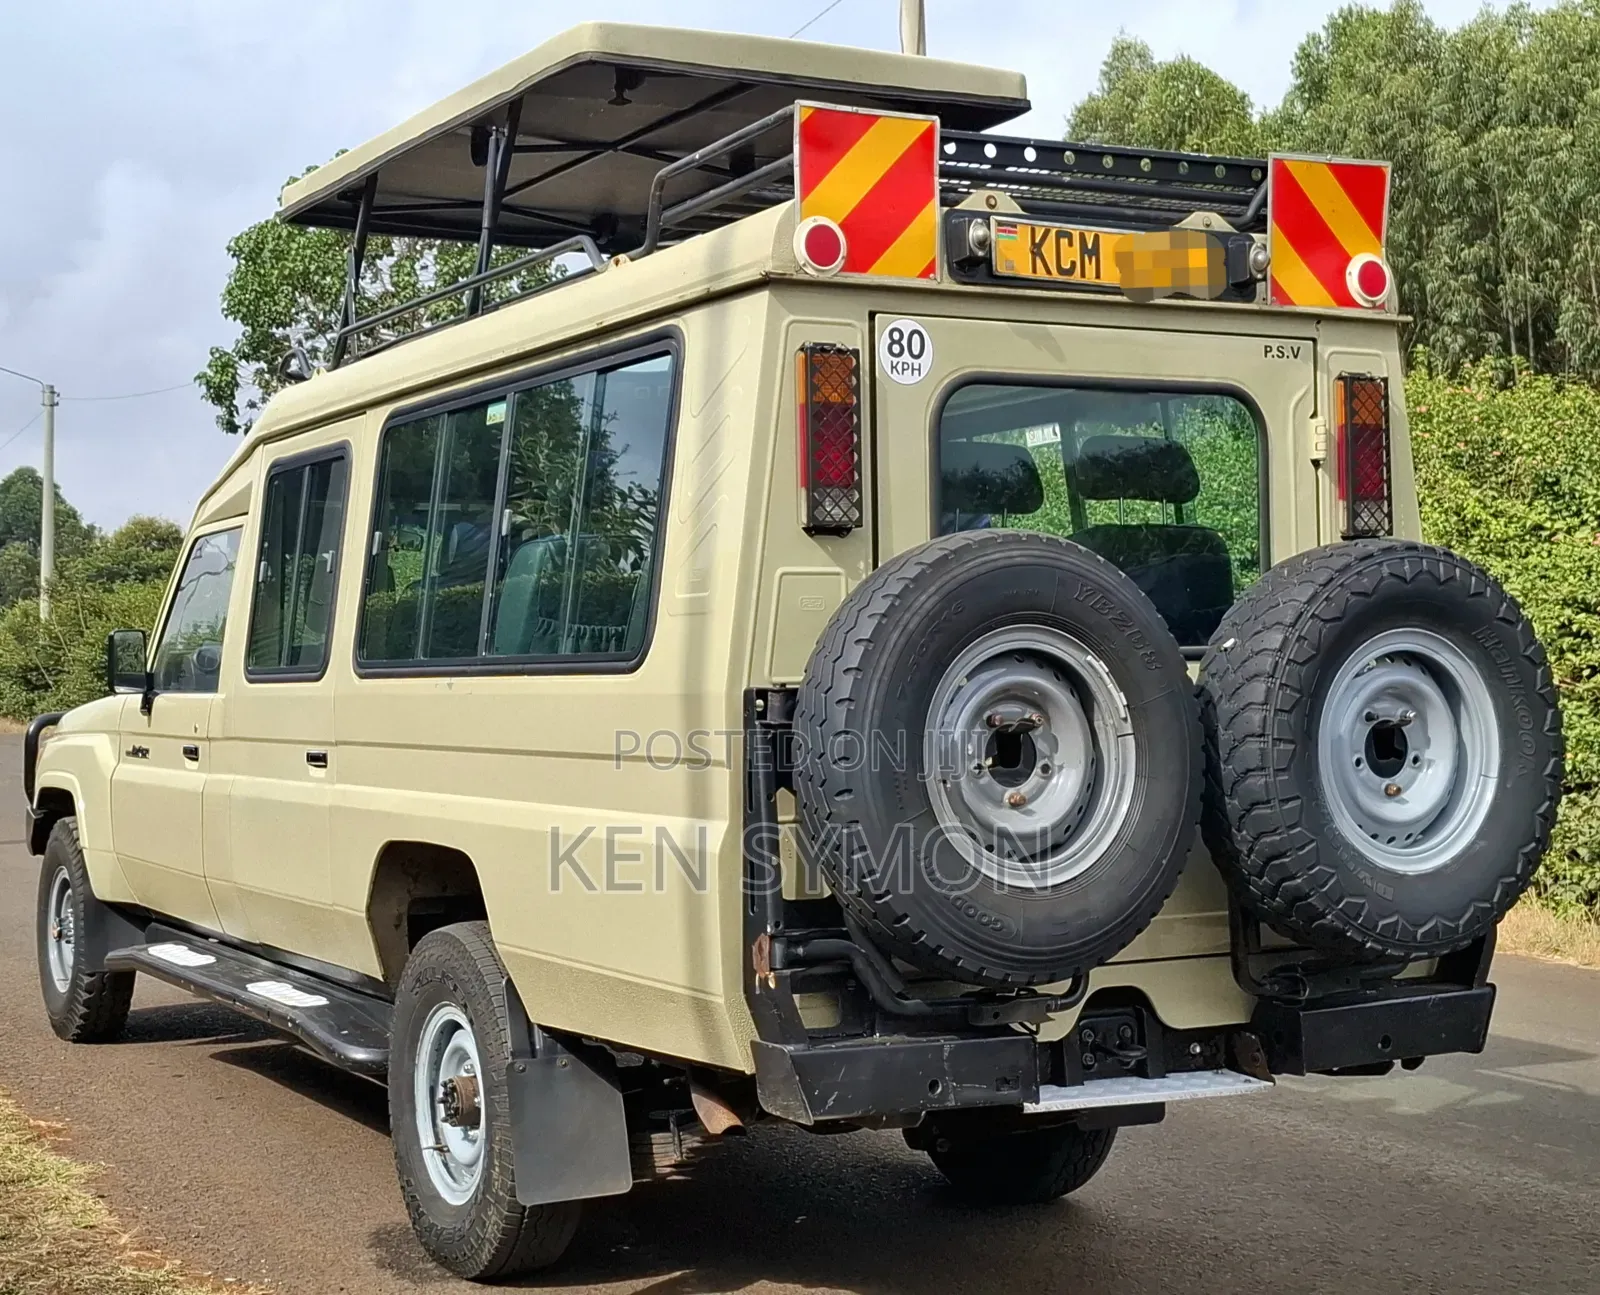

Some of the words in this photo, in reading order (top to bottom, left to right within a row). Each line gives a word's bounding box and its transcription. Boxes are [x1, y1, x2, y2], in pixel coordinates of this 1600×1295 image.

[1029, 225, 1102, 280] KCM
[887, 326, 926, 360] 80
[1263, 344, 1301, 360] P.S.V
[890, 360, 922, 378] KPH
